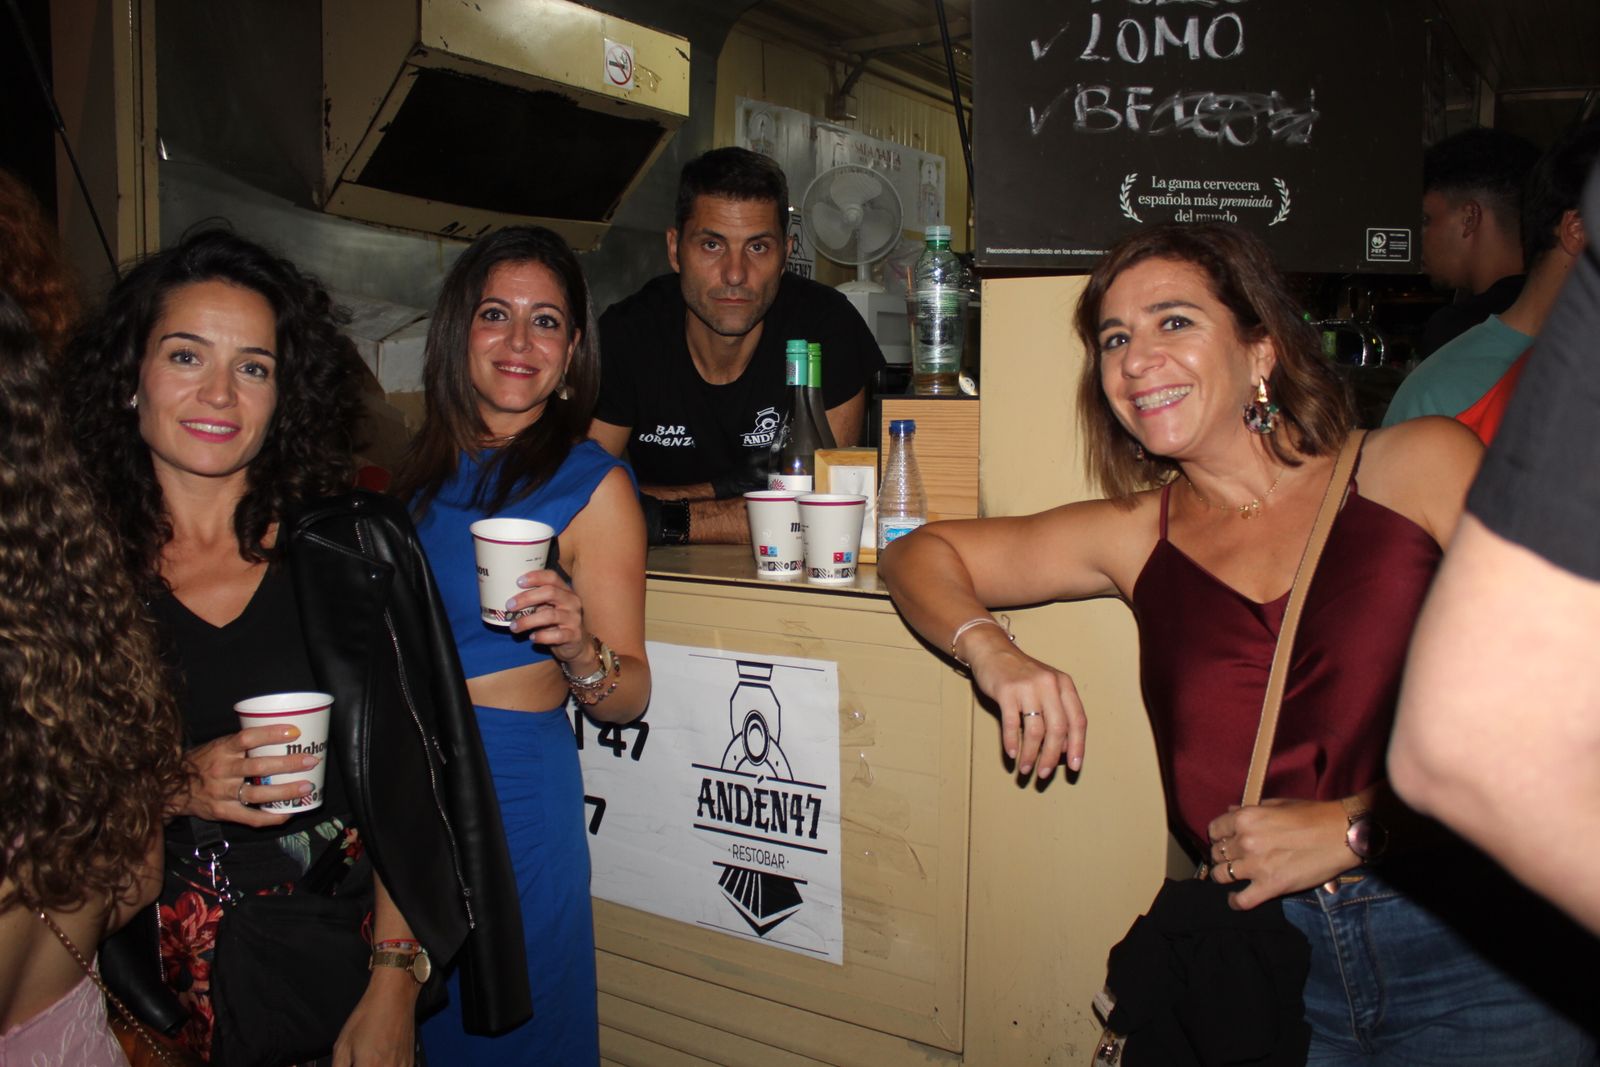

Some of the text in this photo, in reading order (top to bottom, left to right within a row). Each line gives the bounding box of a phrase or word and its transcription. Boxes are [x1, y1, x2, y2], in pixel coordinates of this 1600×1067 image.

[1078, 12, 1245, 63] LOMO
[1151, 176, 1260, 191] La gama cervecera
[1138, 193, 1272, 210] española más premiada
[1175, 209, 1193, 222] del
[986, 247, 1030, 255] Reconocimiento
[1031, 248, 1053, 256] recibido
[655, 424, 686, 436] BAR
[584, 794, 607, 836] 7
[697, 774, 822, 840] ANDÉN47
[732, 844, 785, 869] RESTOBAR
